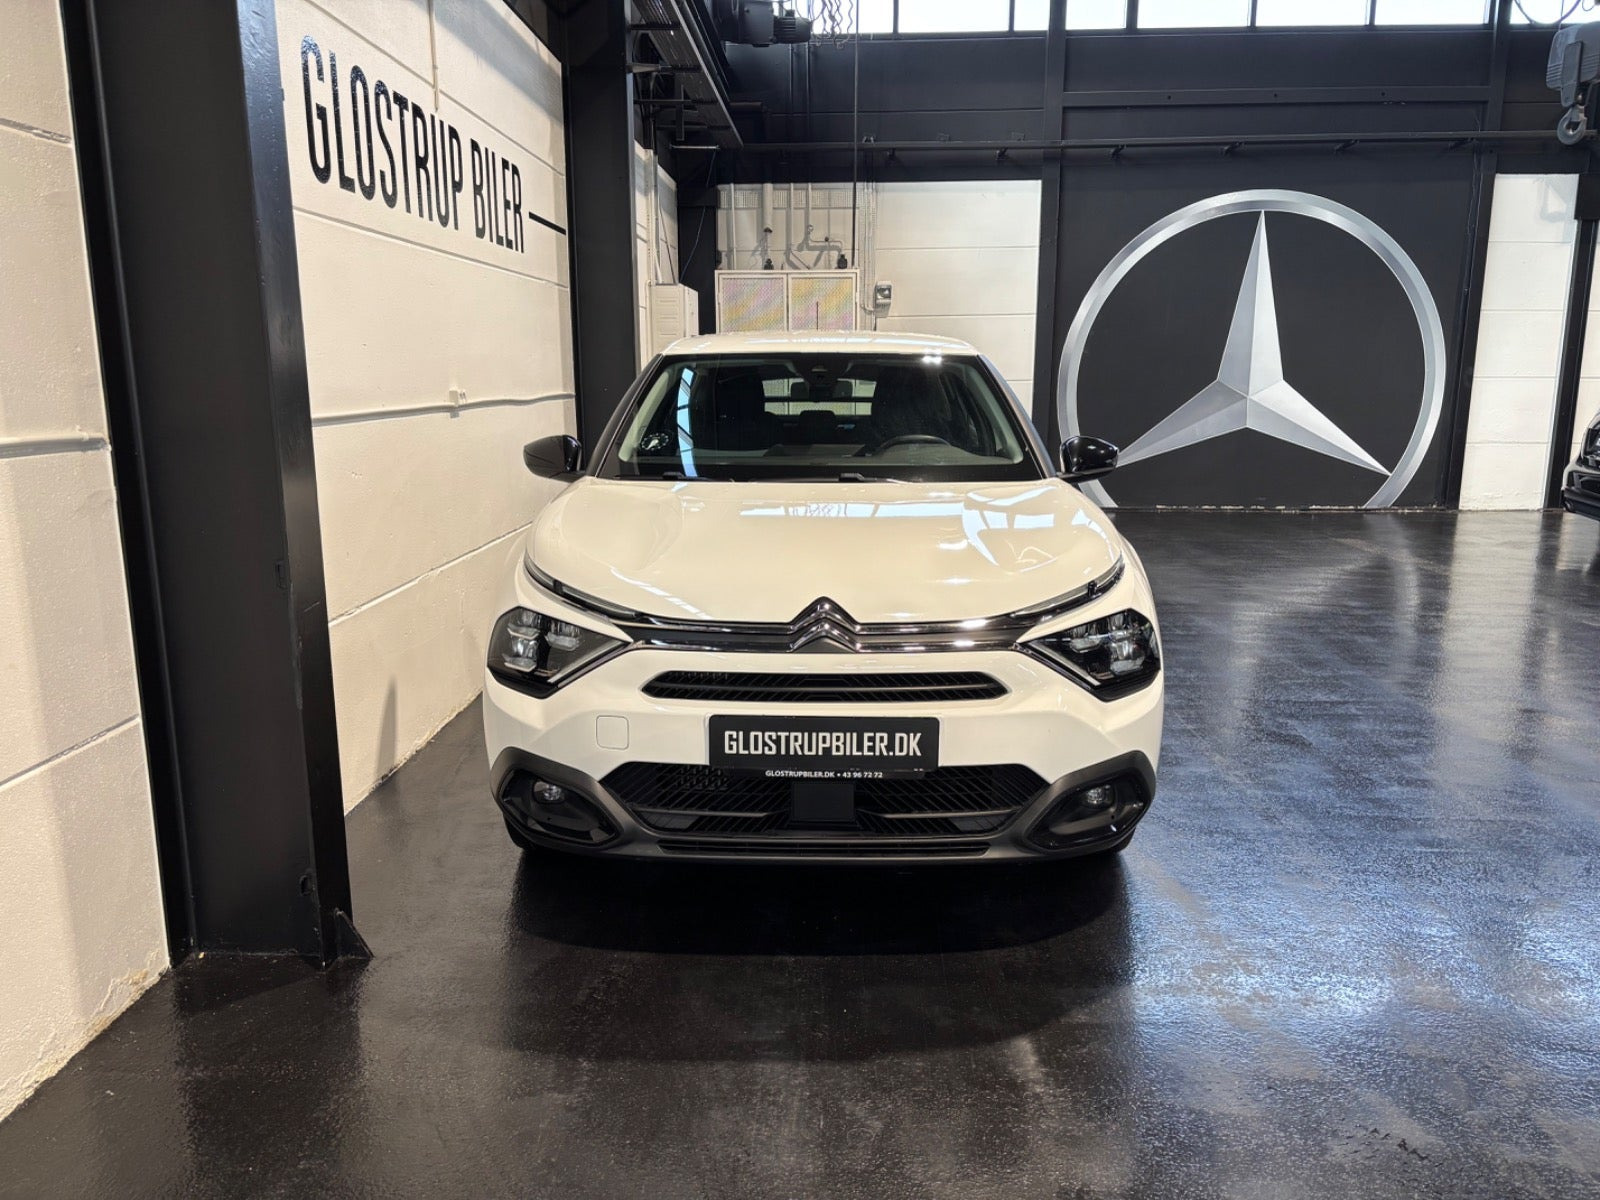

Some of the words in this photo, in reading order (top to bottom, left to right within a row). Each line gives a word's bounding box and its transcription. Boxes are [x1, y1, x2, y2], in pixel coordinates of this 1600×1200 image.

[300, 35, 463, 231] GLOSTRUP
[470, 137, 525, 254] BILER
[724, 730, 922, 757] GLOSTRUPBILER.DK
[765, 769, 835, 778] GLOSTRUPBILER.DK
